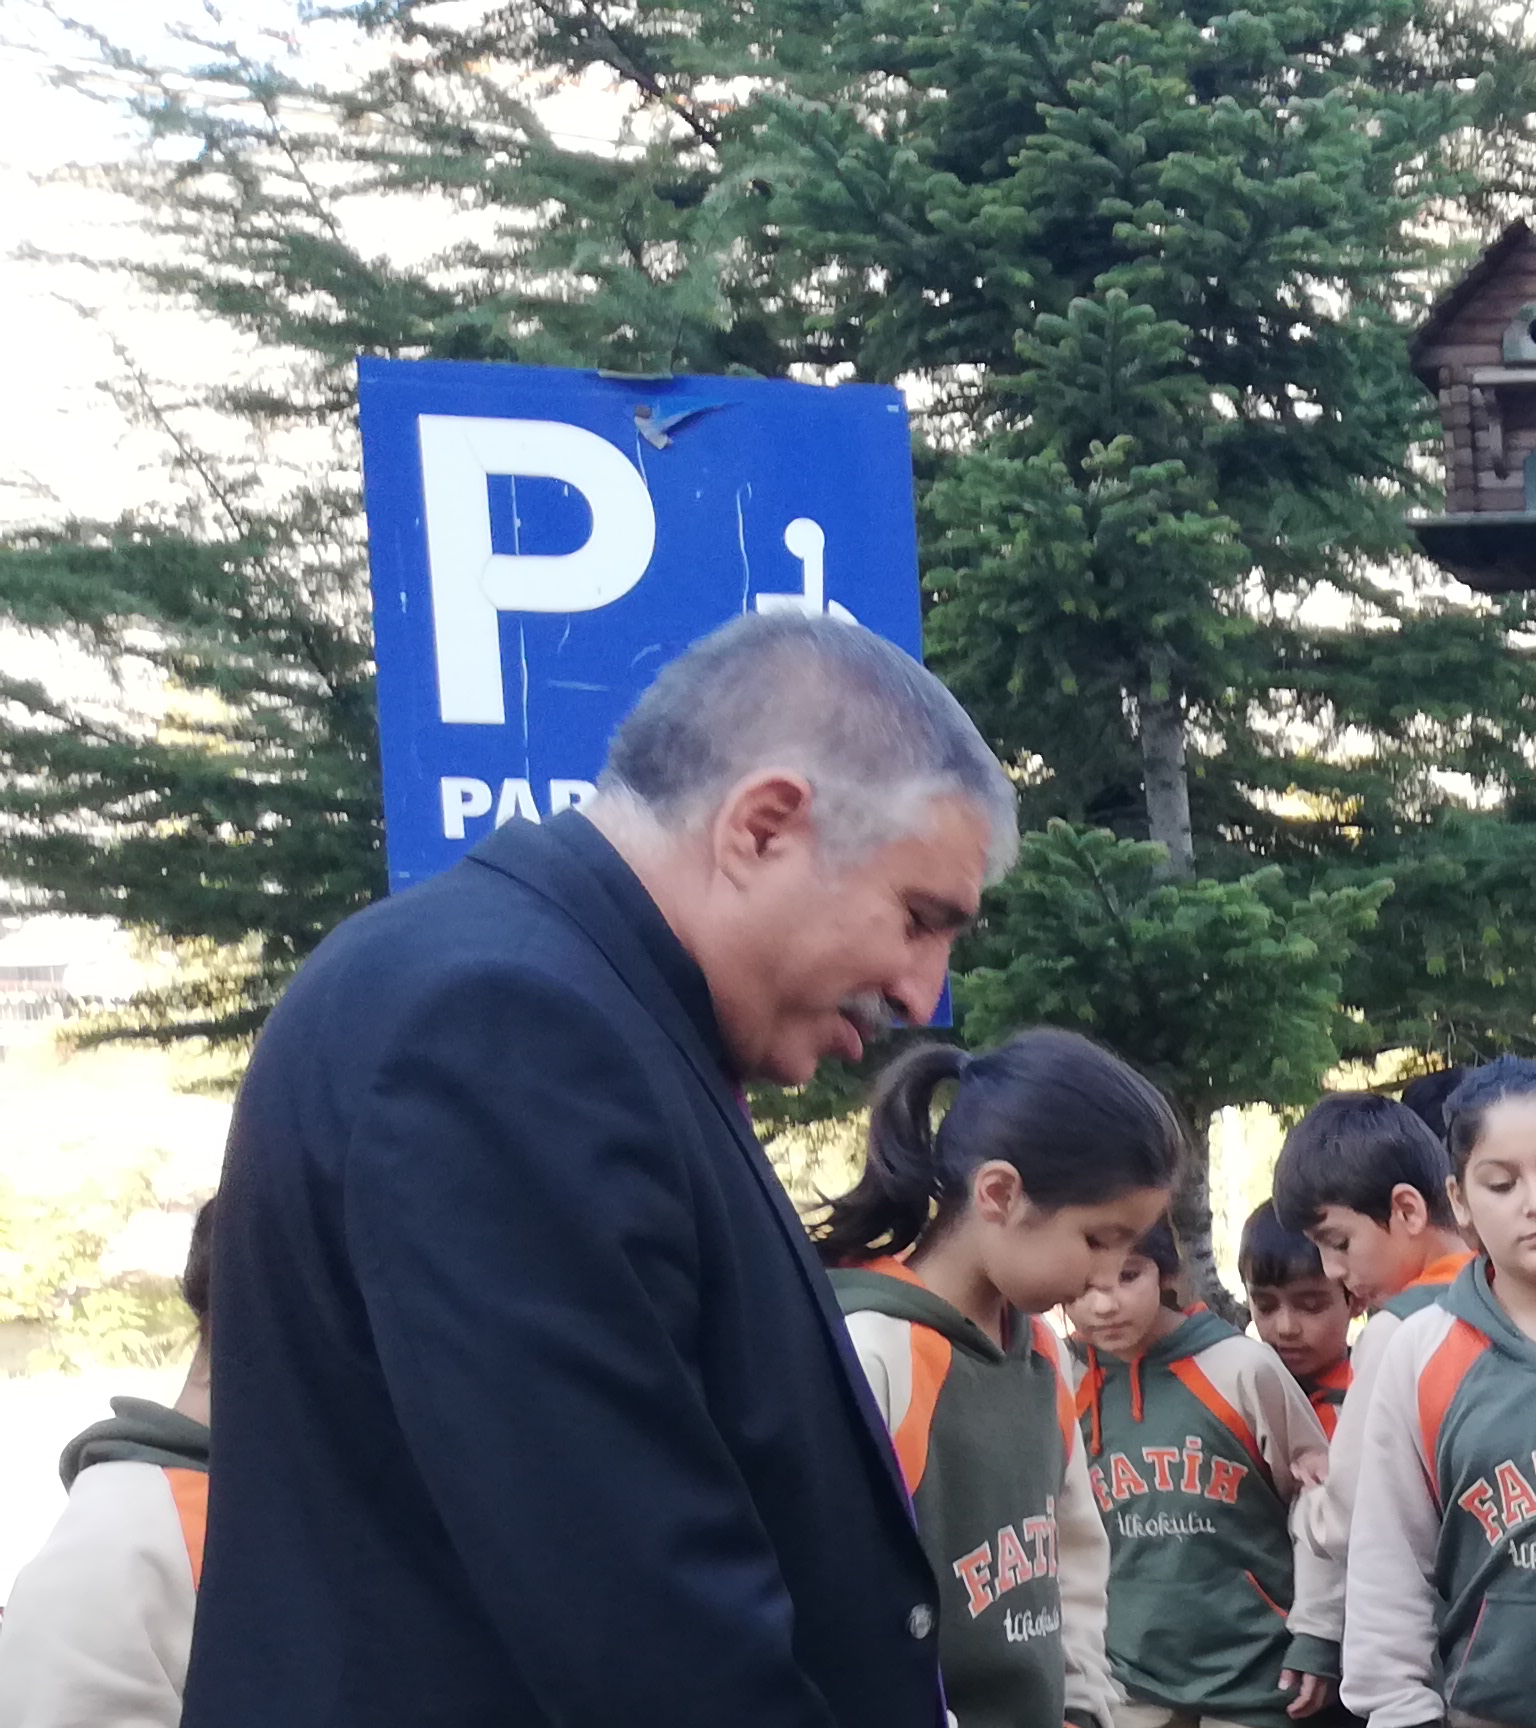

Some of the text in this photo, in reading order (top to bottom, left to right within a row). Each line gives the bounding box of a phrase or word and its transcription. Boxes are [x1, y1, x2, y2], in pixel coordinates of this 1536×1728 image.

[418, 413, 656, 725] P
[1089, 1435, 1249, 1512] FATİH
[952, 1494, 1060, 1620] FATİ
